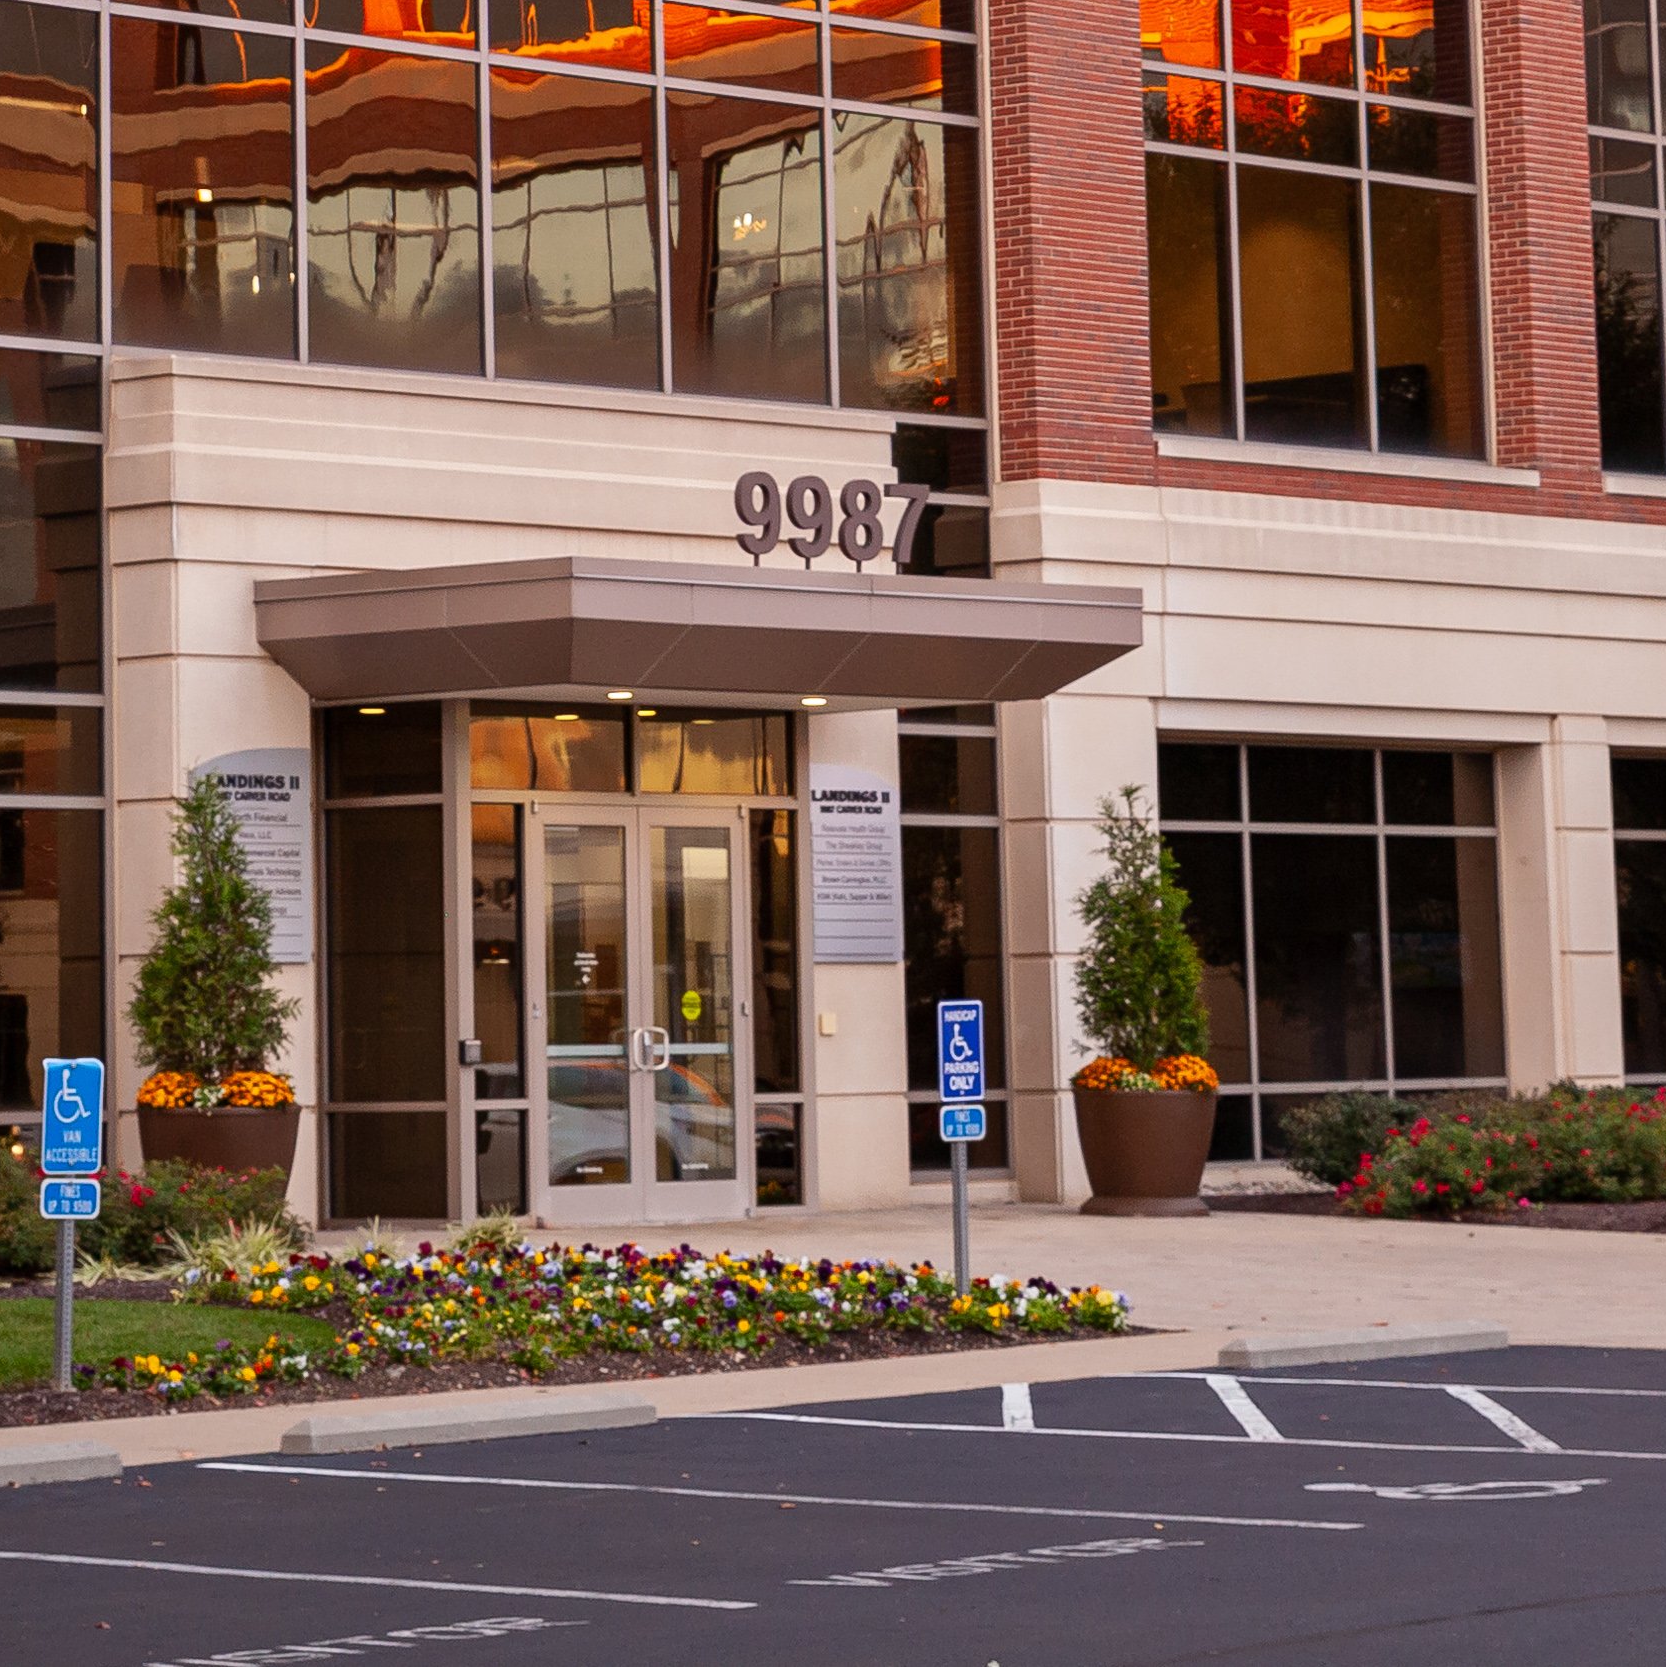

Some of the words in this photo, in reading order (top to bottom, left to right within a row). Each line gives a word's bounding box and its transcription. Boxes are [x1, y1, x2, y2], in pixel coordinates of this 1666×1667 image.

[734, 470, 931, 564] 9987
[207, 774, 286, 790] ANDINGS
[289, 775, 300, 790] II
[234, 791, 266, 801] CARVER
[268, 792, 291, 802] ROAD
[811, 789, 878, 803] LANDINGS
[881, 791, 890, 803] II
[949, 1075, 975, 1091] ONLY
[63, 1130, 82, 1143] VAN
[46, 1147, 98, 1163] ACCESSIBLE
[47, 1199, 58, 1213] UP
[61, 1199, 71, 1213] TO
[784, 1537, 1205, 1588] VISITOR
[143, 1615, 591, 1667] ISITOR
